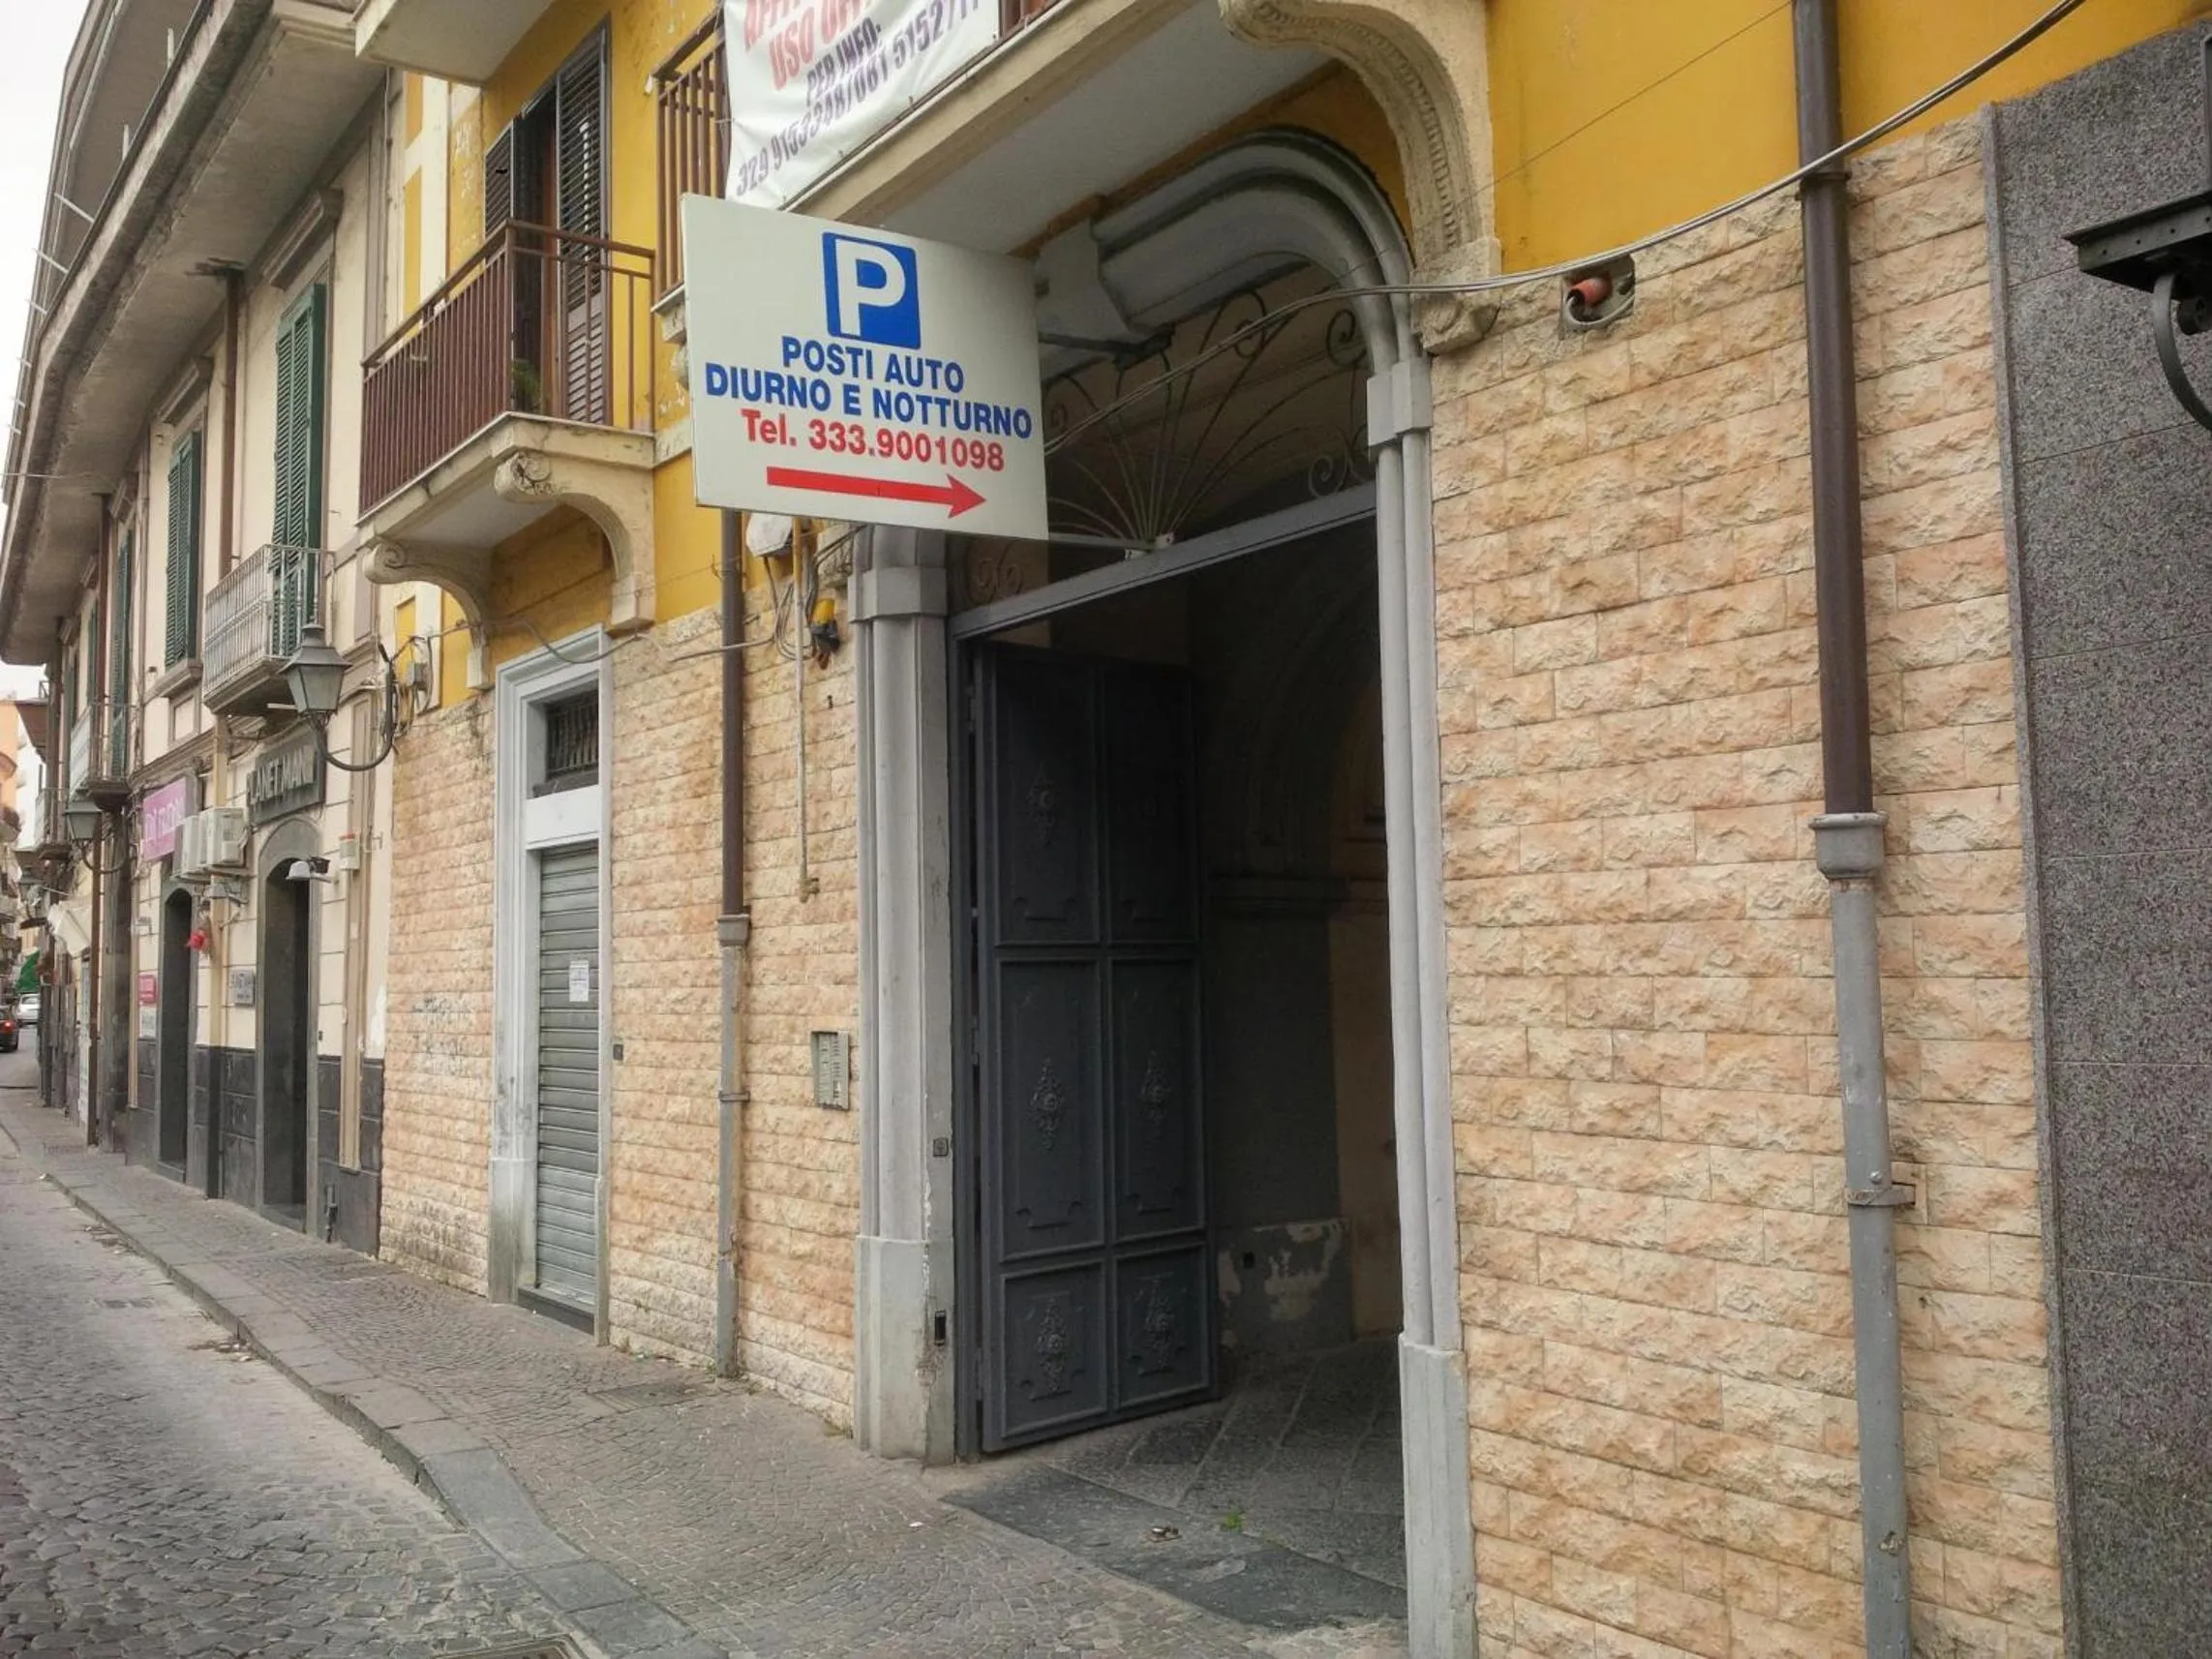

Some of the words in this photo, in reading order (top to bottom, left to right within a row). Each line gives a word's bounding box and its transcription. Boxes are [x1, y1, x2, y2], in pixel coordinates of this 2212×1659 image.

[769, 7, 814, 91] USO
[806, 54, 835, 107] PER
[737, 147, 769, 196] 329
[835, 238, 906, 338] P
[781, 335, 873, 380] POSTI
[885, 352, 964, 394] AUTO
[705, 362, 832, 412] DIURNO
[843, 384, 862, 416] E
[872, 388, 1032, 439] NOTTURNO
[741, 408, 798, 447] Tel.
[808, 419, 1005, 472] 333.9001098
